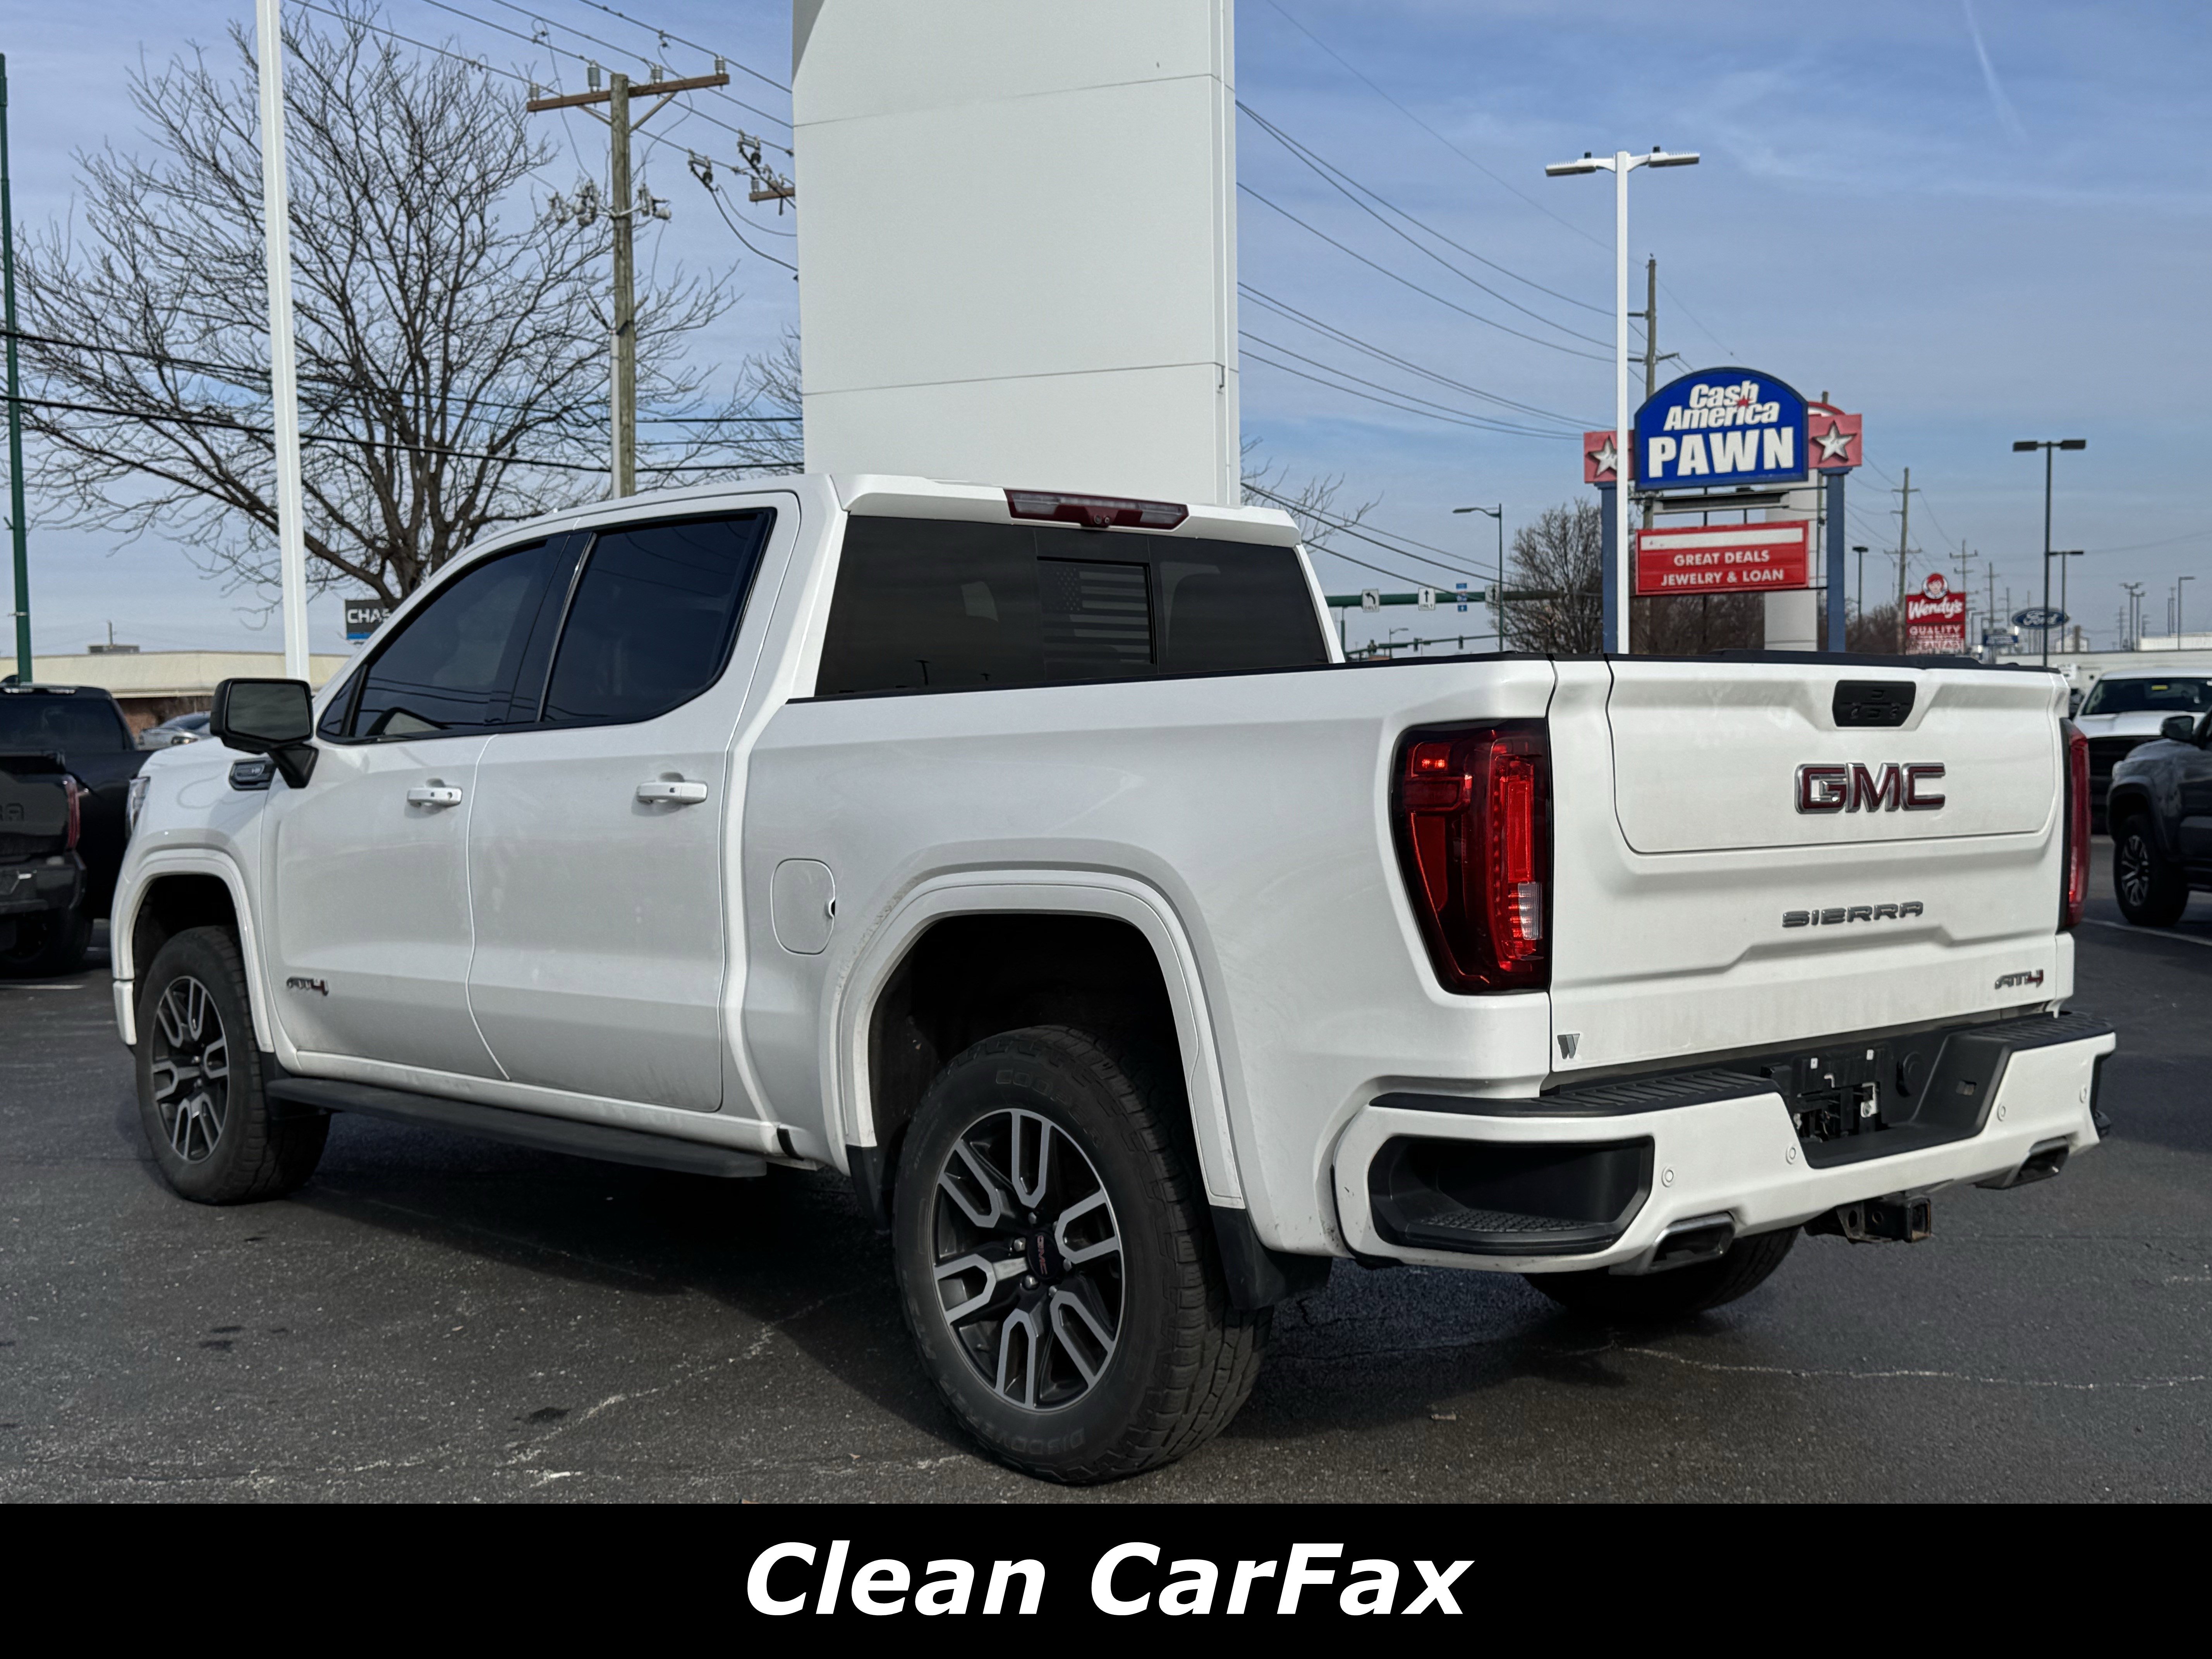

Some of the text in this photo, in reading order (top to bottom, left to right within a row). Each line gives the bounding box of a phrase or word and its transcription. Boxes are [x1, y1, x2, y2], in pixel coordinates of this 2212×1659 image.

[1689, 380, 1760, 409] Cash
[1663, 401, 1780, 431] America
[1649, 426, 1794, 478] PAWN
[1674, 550, 1770, 566] GREAT DEALS
[1661, 568, 1784, 586] JEWELRY & LOAN
[347, 608, 391, 623] CHAS
[1908, 596, 1963, 620] Wendy's
[2023, 610, 2059, 626] Fod
[1909, 624, 1961, 635] QUALITY
[1795, 762, 1946, 814] GMC
[1782, 901, 1923, 928] SIERRA
[1995, 969, 2044, 990] AT4
[1037, 1235, 1048, 1275] GMC
